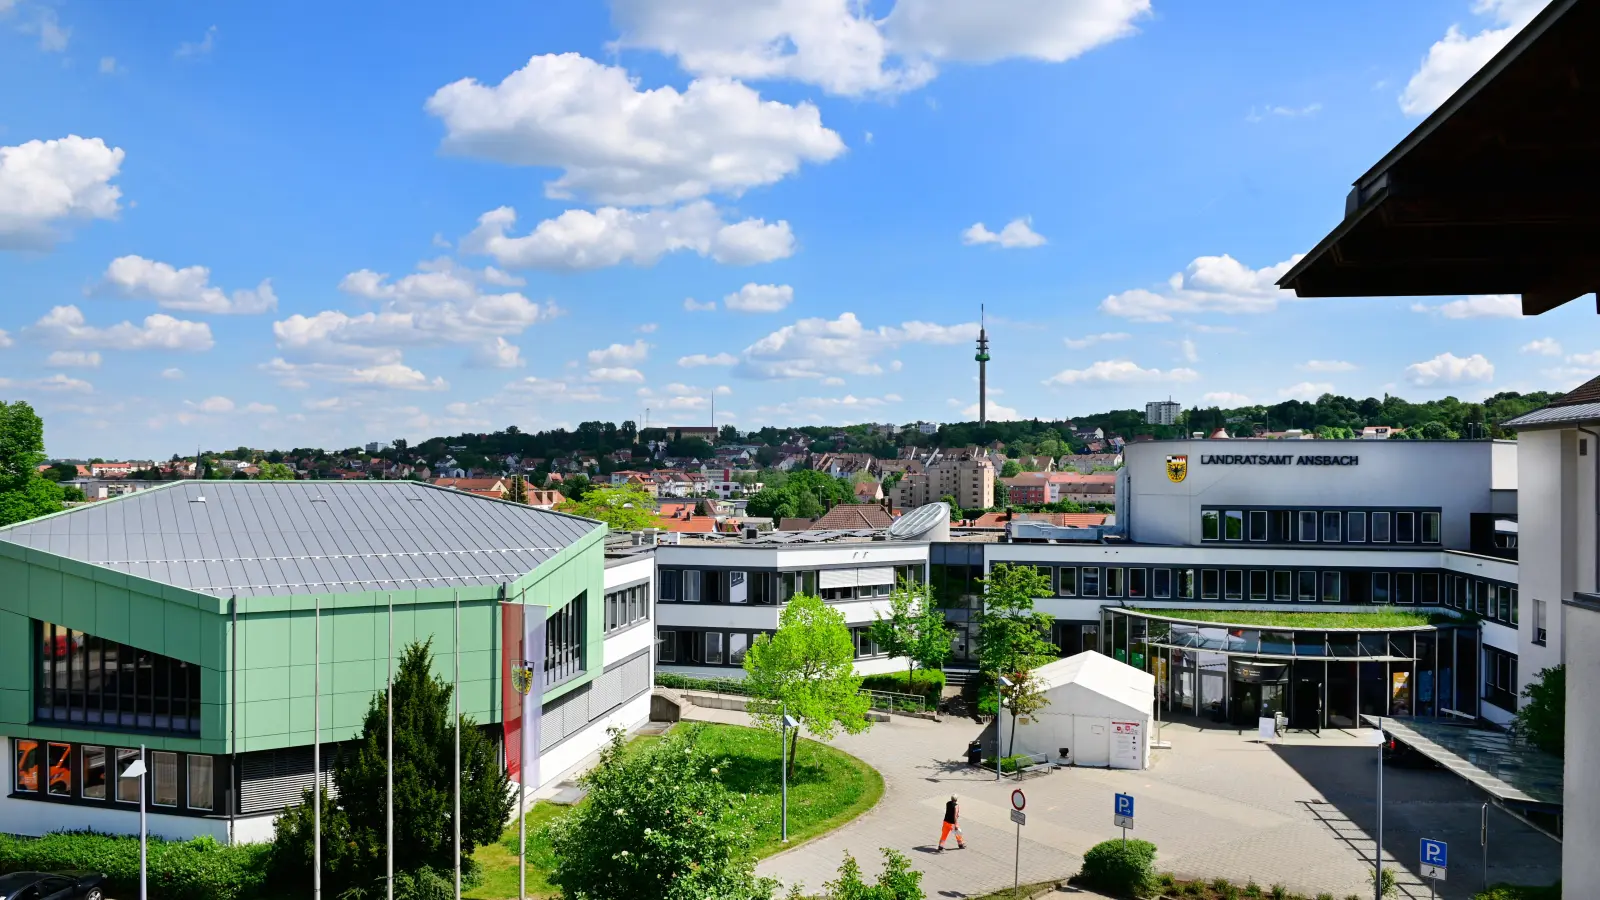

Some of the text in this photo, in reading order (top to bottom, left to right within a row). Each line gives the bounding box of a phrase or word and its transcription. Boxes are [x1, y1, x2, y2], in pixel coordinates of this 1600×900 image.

[1200, 454, 1359, 466] LANDRATSAMT ANSBACH
[1119, 797, 1129, 812] P
[1426, 842, 1440, 860] P
